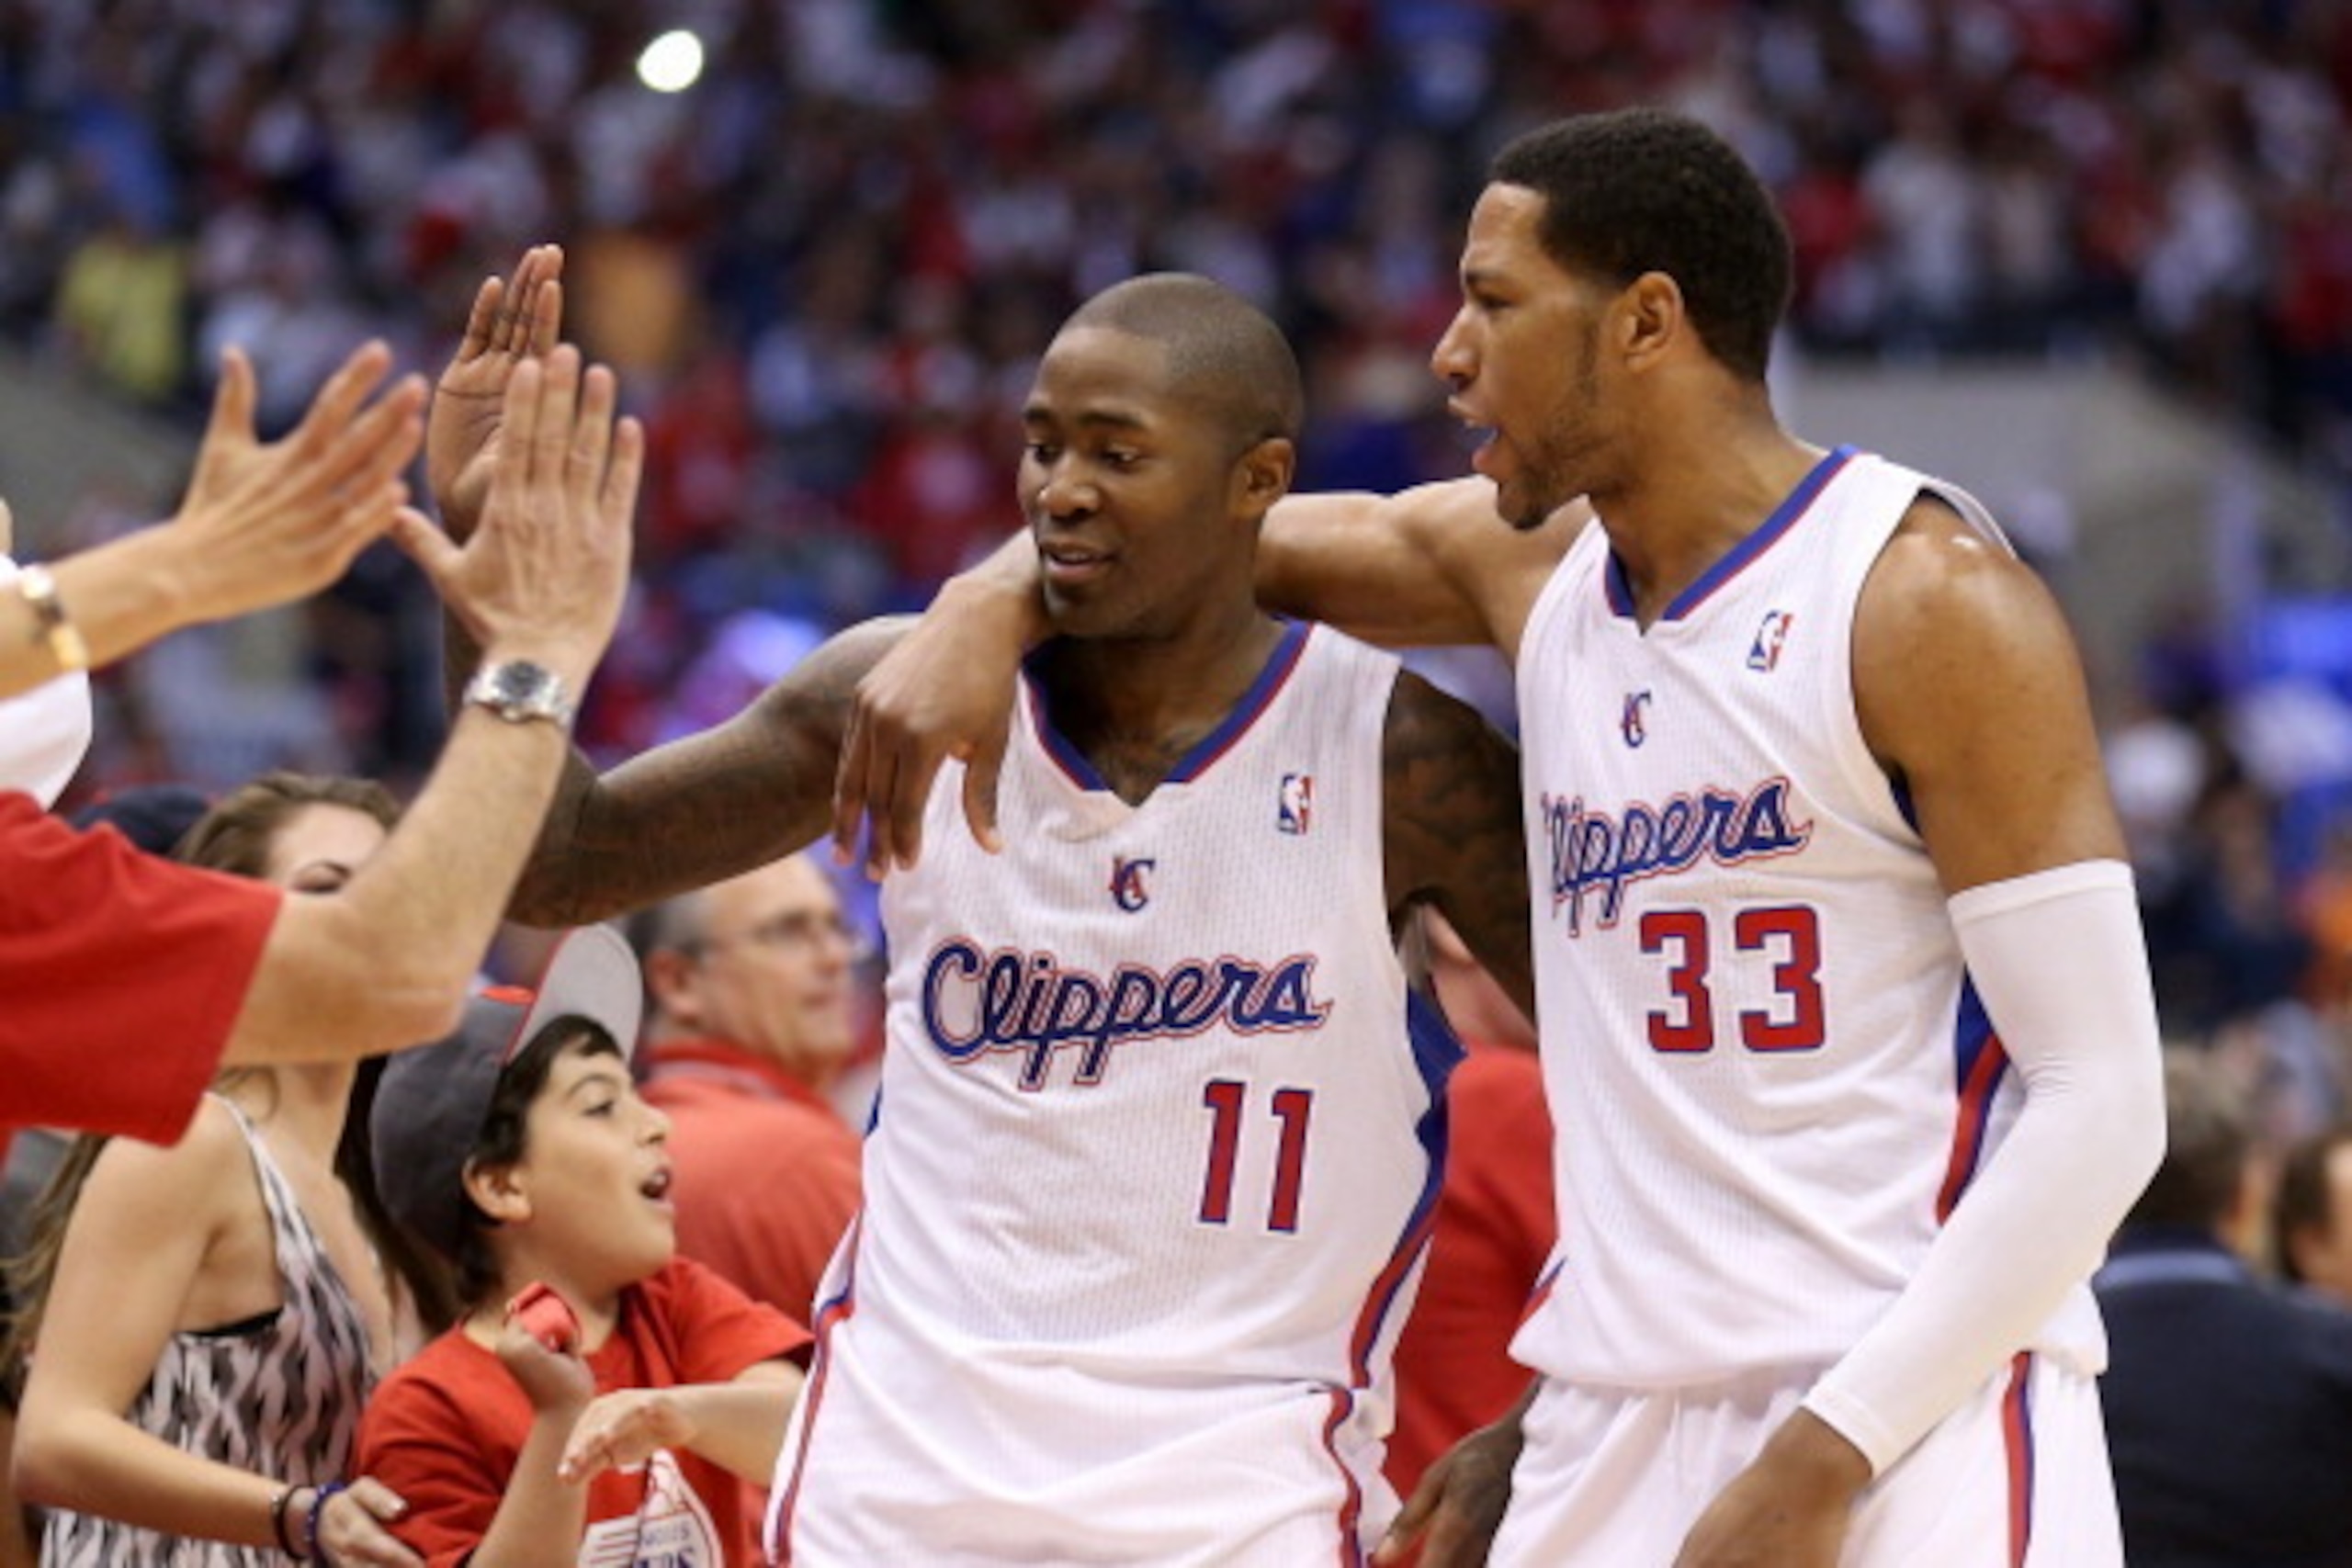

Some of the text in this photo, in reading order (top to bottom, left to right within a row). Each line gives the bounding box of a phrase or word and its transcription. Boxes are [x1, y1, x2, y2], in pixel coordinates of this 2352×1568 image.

[1541, 775, 1813, 937] lippers
[922, 935, 1334, 1091] Clippers
[1639, 903, 1826, 1054] 33
[1198, 1078, 1314, 1235] 11
